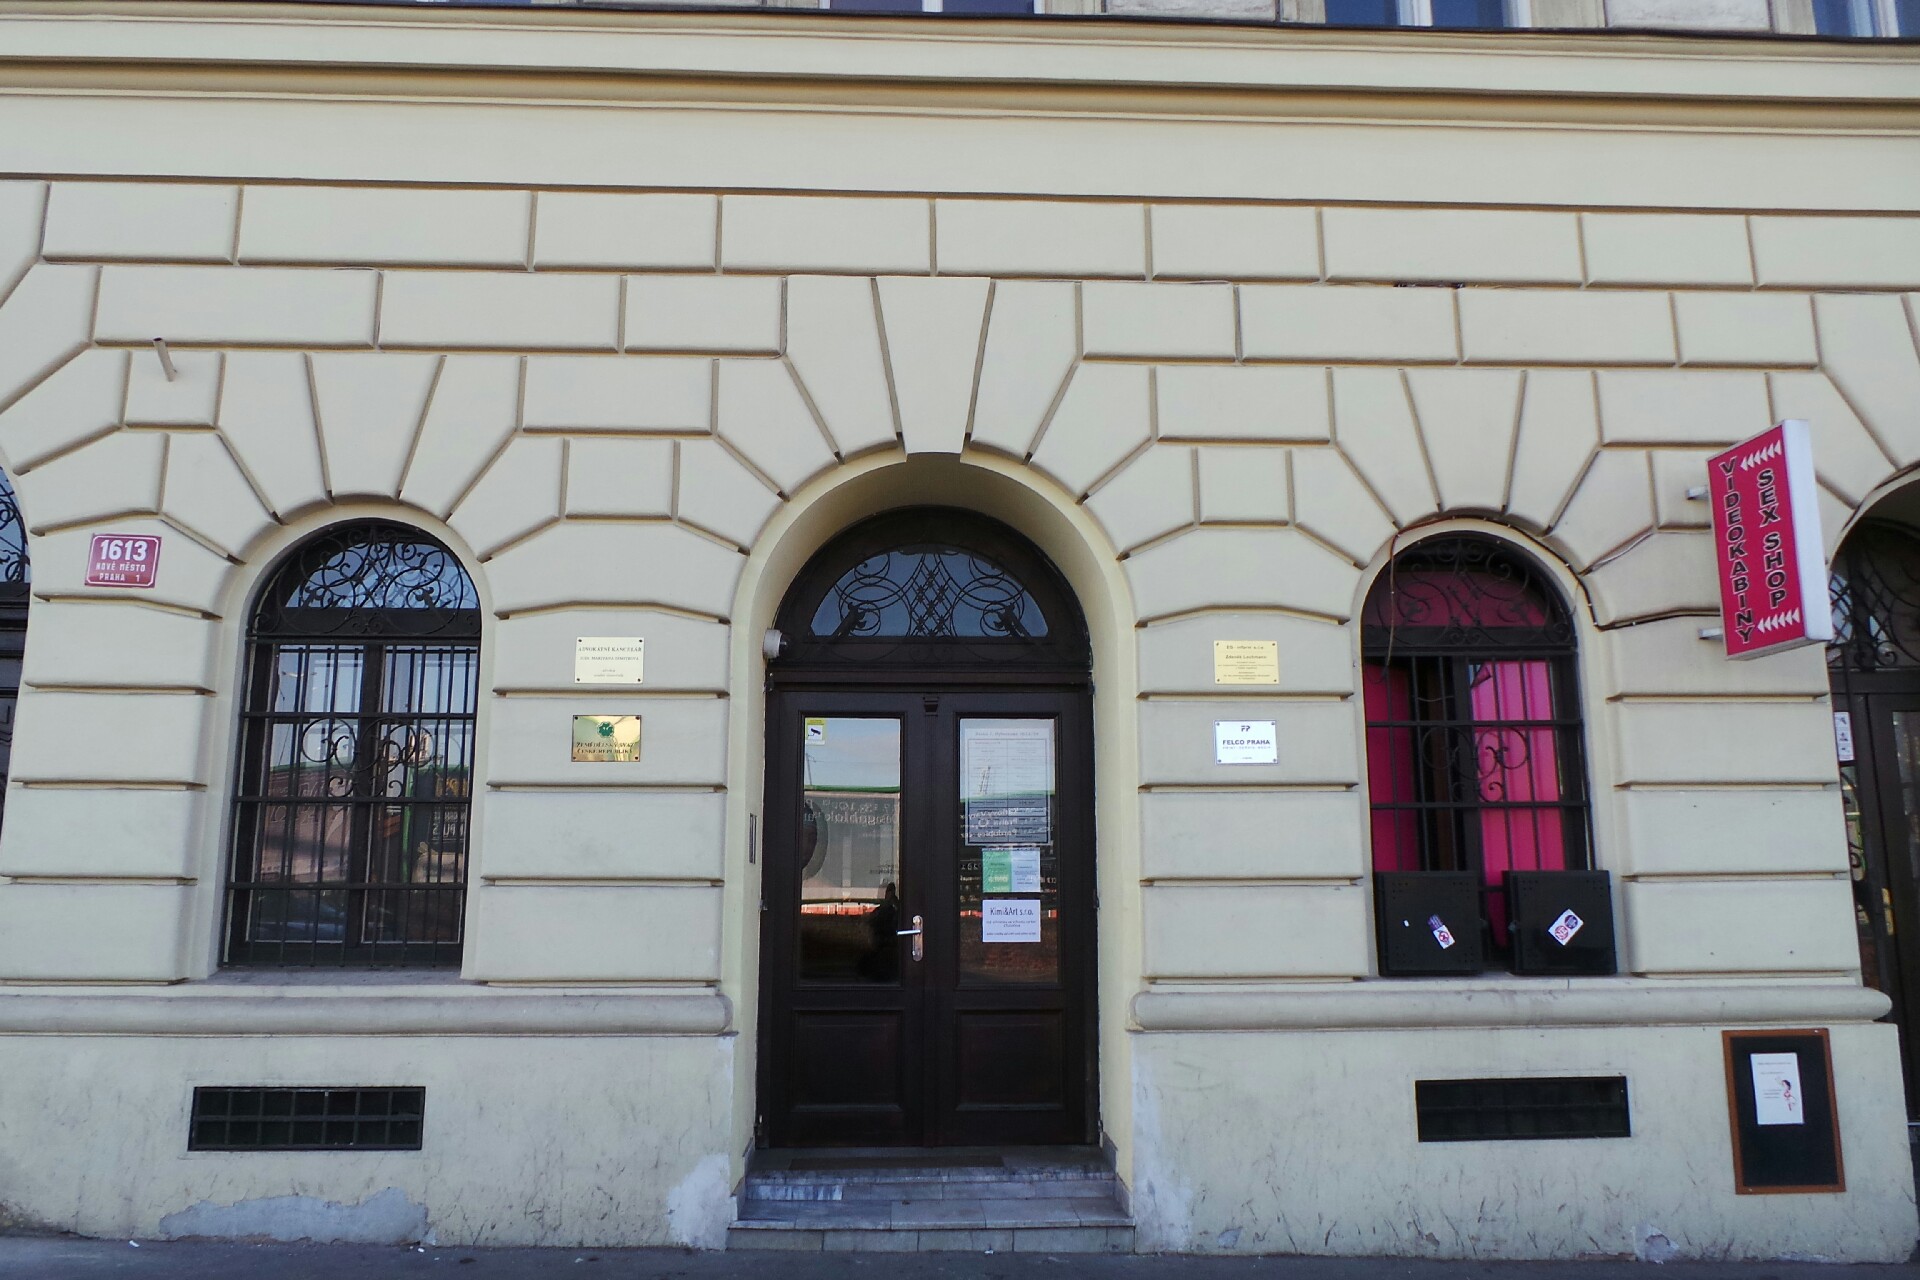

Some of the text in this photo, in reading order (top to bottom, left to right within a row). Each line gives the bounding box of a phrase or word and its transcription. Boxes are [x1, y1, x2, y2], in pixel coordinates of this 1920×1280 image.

[1757, 468, 1787, 610] SEX SHOP
[100, 539, 148, 561] 1613
[1719, 457, 1756, 644] VIDEOKABINY
[95, 561, 146, 572] NOVÉ MĚSTO
[99, 572, 141, 582] PRAHA 1
[990, 906, 1018, 916] Kimi&Art
